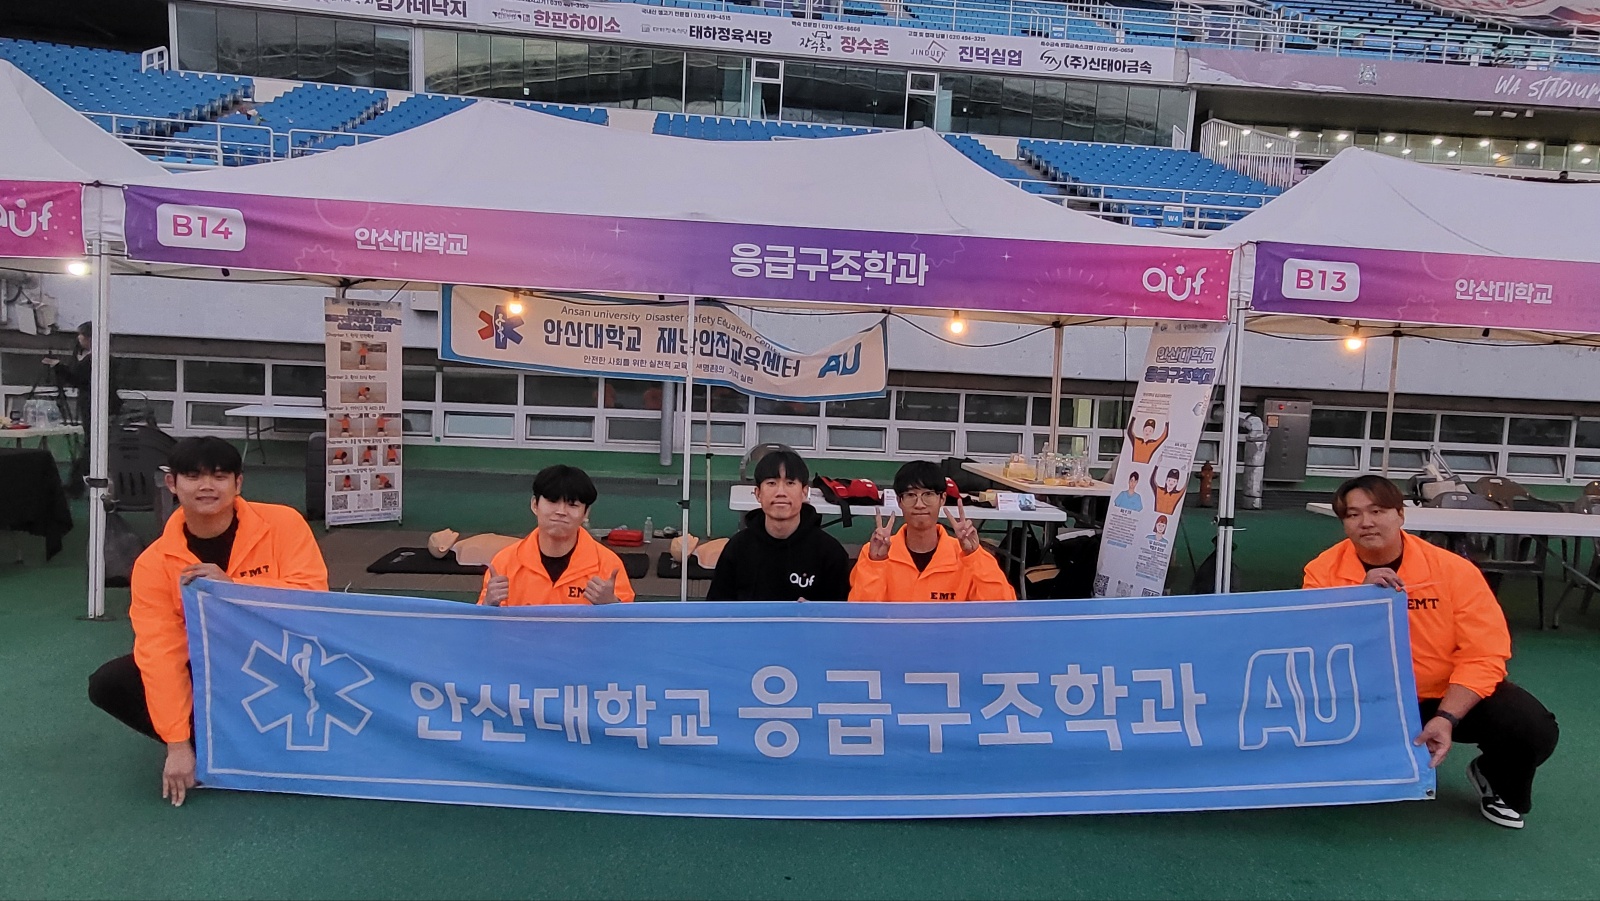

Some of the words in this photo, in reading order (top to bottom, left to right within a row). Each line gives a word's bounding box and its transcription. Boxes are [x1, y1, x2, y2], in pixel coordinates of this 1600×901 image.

[534, 9, 621, 33] 한판하이소
[689, 25, 773, 45] 태하정육식당
[840, 36, 889, 56] 장수촌
[958, 46, 1023, 66] 진덕실업
[1064, 55, 1152, 75] (주)신태아금속
[1494, 74, 1522, 96] WA
[171, 213, 233, 241] B14
[354, 226, 469, 257] 안산대학교
[729, 242, 929, 287] 응급구조학과
[1295, 268, 1348, 292] B13
[1454, 278, 1553, 306] 안산대학교
[560, 306, 591, 317] Ansan
[593, 311, 641, 322] university
[645, 313, 685, 323] Disaster
[687, 313, 716, 327] afety
[543, 319, 642, 352] 안산대학교
[656, 326, 801, 378] 재난안전교육센터
[1156, 346, 1217, 364] 안산대학교
[583, 355, 607, 366] 안전한
[607, 357, 630, 367] 사회를
[632, 359, 648, 368] 위한
[649, 360, 672, 369] 실천적
[817, 342, 863, 379] AU
[1144, 366, 1217, 385] 응급구조학과
[568, 586, 586, 598] EM
[930, 592, 957, 600] EMT
[1407, 598, 1440, 610] EMT
[409, 682, 719, 750] 안산대학교
[737, 663, 1207, 758] 응급구조학과
[1238, 644, 1361, 750] AU
